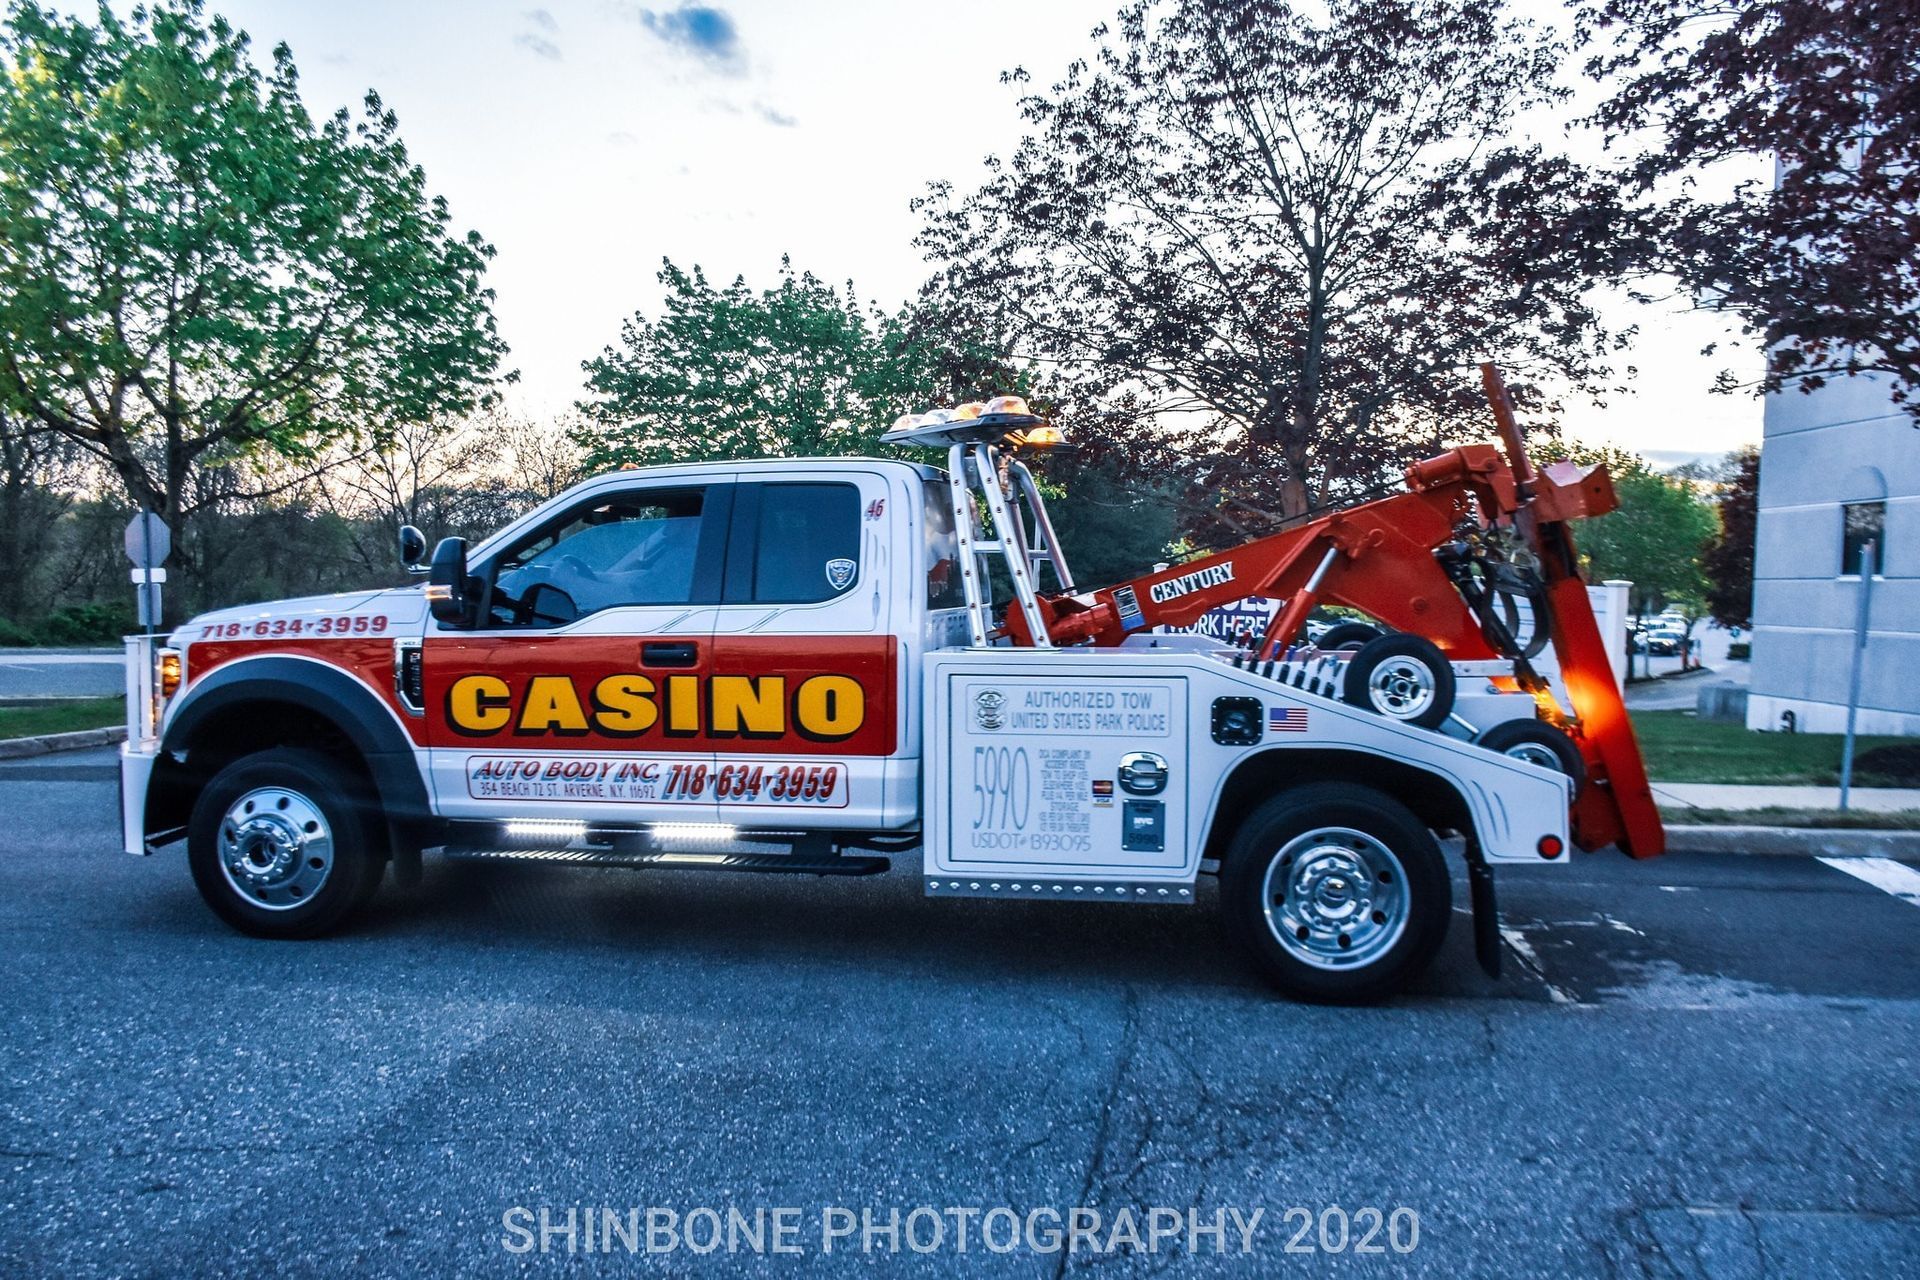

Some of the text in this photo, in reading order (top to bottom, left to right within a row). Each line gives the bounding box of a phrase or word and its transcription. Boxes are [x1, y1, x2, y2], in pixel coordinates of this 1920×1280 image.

[866, 498, 885, 518] 46
[1150, 561, 1236, 604] CENTURY
[447, 674, 865, 740] CASINO
[1024, 691, 1152, 709] AUTHORIZED TOW
[1011, 712, 1165, 731] UNITED STATES PARK POLICE
[474, 761, 660, 783] AUTO BODY INC.
[480, 782, 497, 795] 354
[501, 782, 529, 796] BEACH
[532, 783, 543, 797] 72
[629, 785, 656, 799] 11692
[973, 746, 1030, 830] 5990
